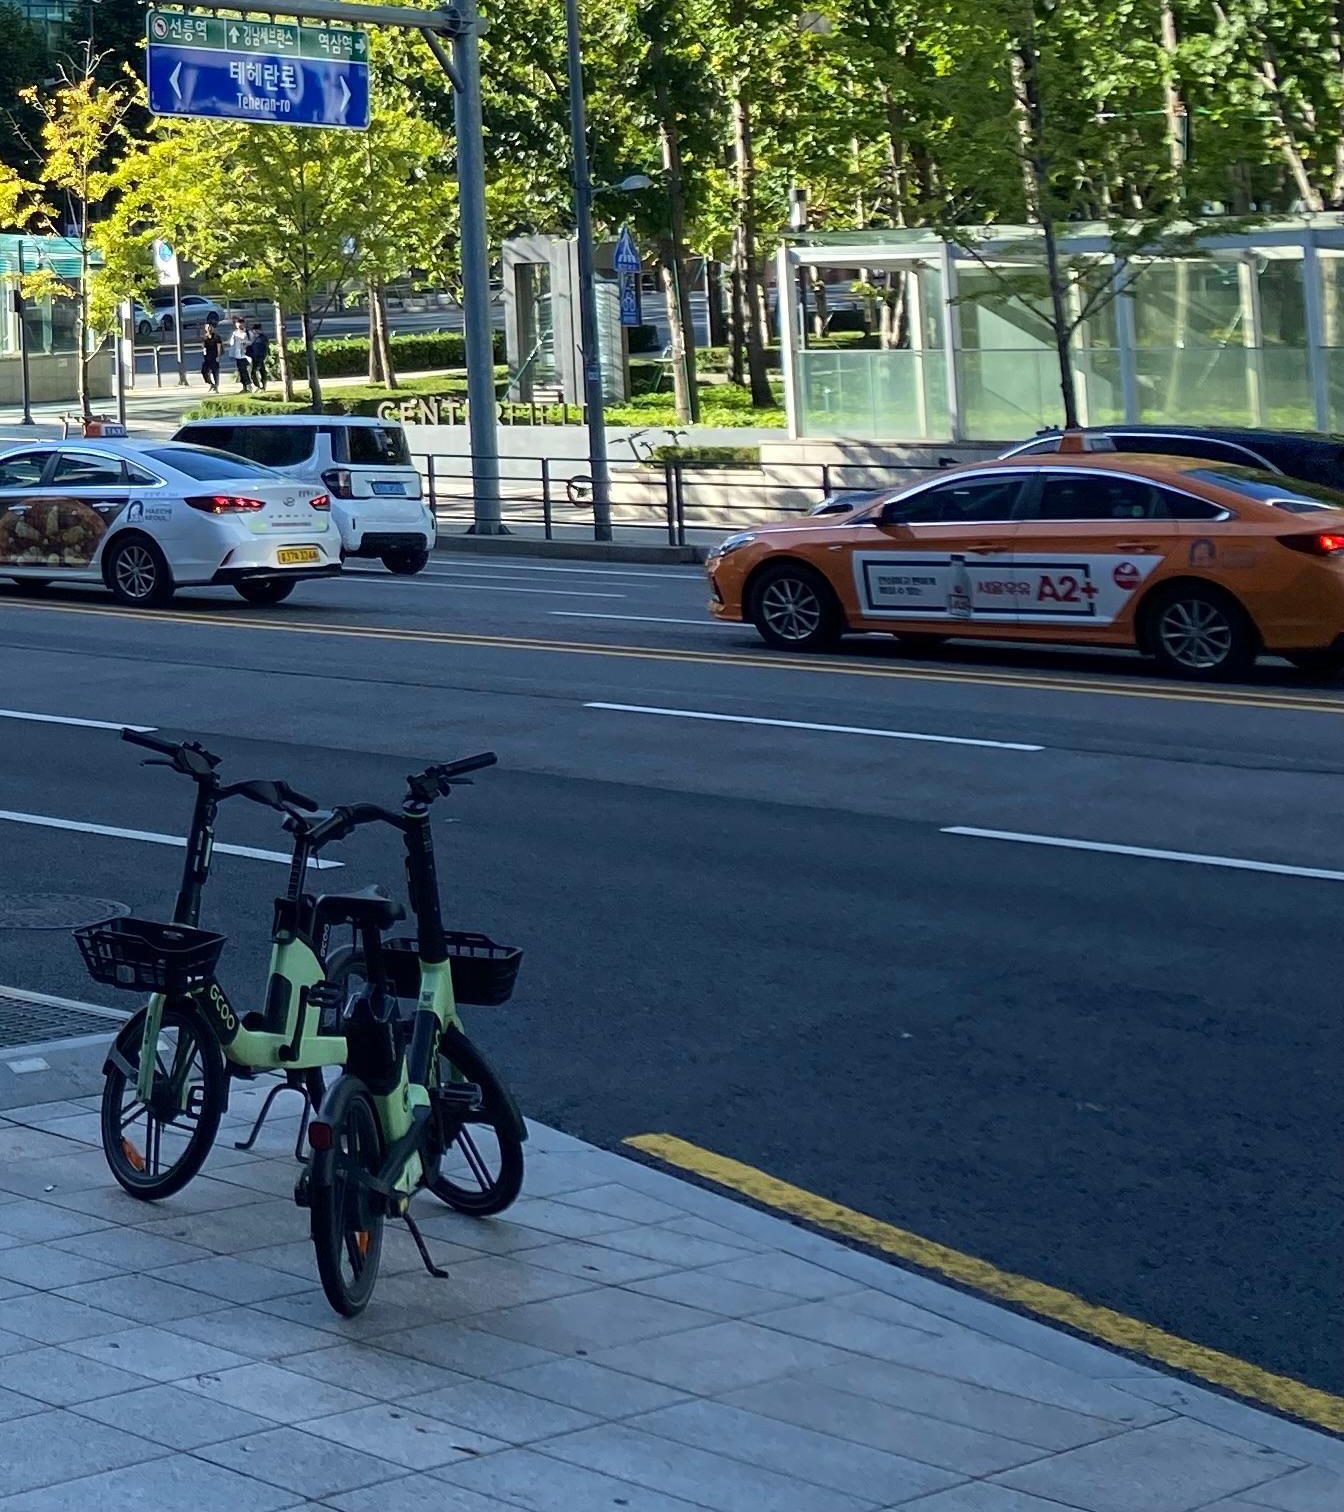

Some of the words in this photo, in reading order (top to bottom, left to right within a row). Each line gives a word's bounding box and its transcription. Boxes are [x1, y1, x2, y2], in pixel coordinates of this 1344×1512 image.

[169, 18, 207, 41] 선릉역
[243, 26, 294, 48] 강남세브란스
[318, 33, 353, 55] 역삼역
[229, 61, 296, 91] 테헤란로
[236, 92, 291, 113] Teheran-ro
[1037, 575, 1098, 603] A2+
[320, 923, 330, 957] GCOO
[210, 984, 235, 1031] GCOO
